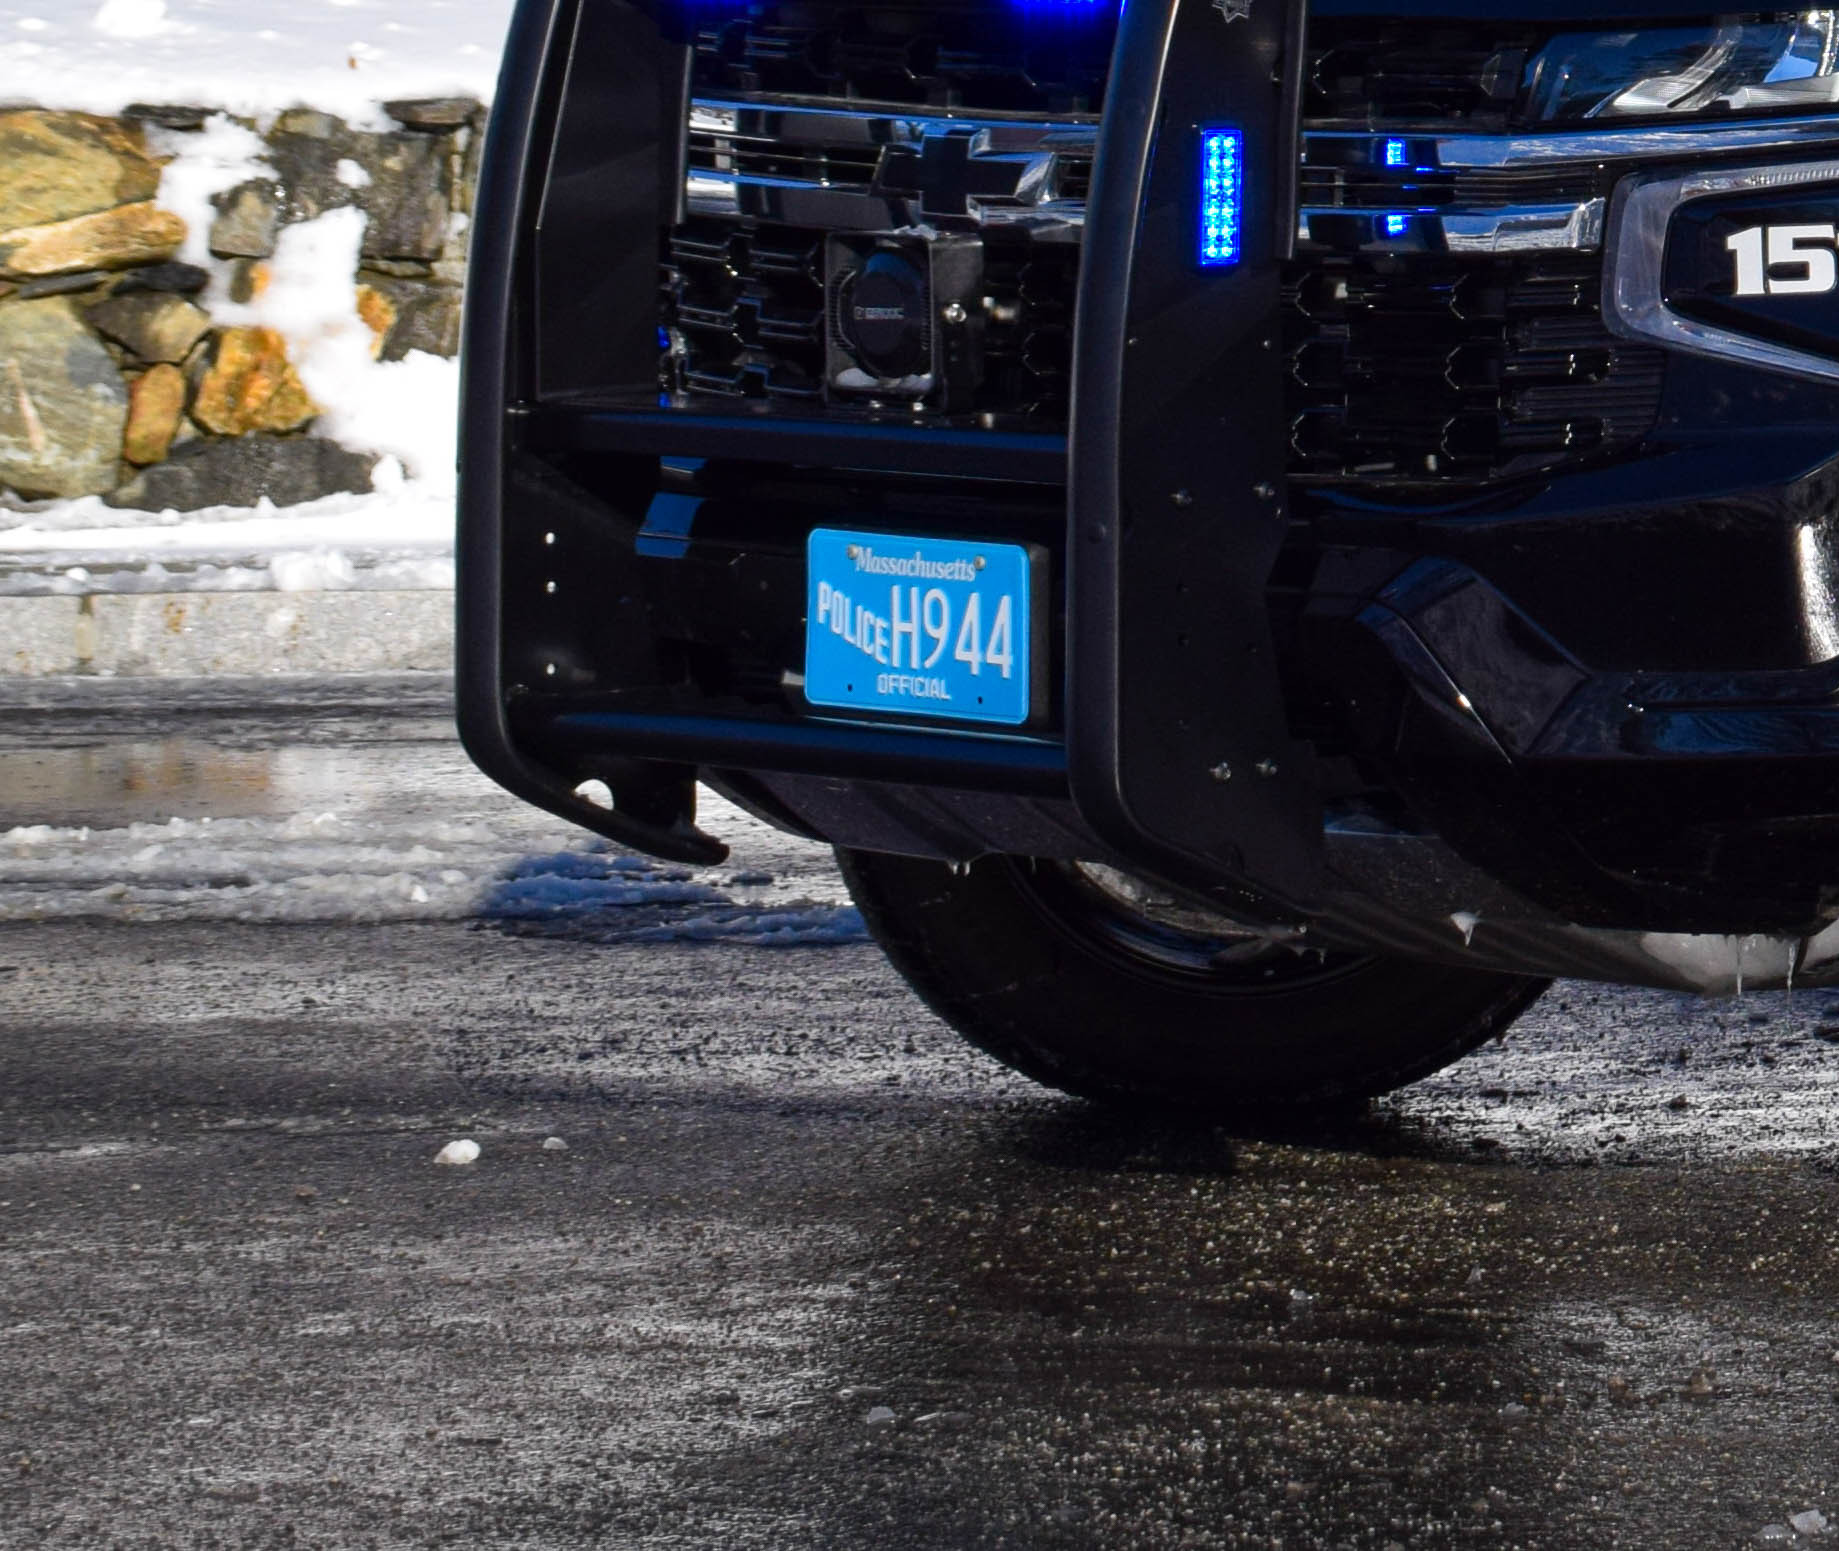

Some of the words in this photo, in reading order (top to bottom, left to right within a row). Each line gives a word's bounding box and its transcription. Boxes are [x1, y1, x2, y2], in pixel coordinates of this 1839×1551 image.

[856, 546, 976, 582] Massachusetts
[817, 581, 889, 665] POLICE
[891, 584, 1013, 679] H944
[876, 673, 952, 700] OFFICIAL
